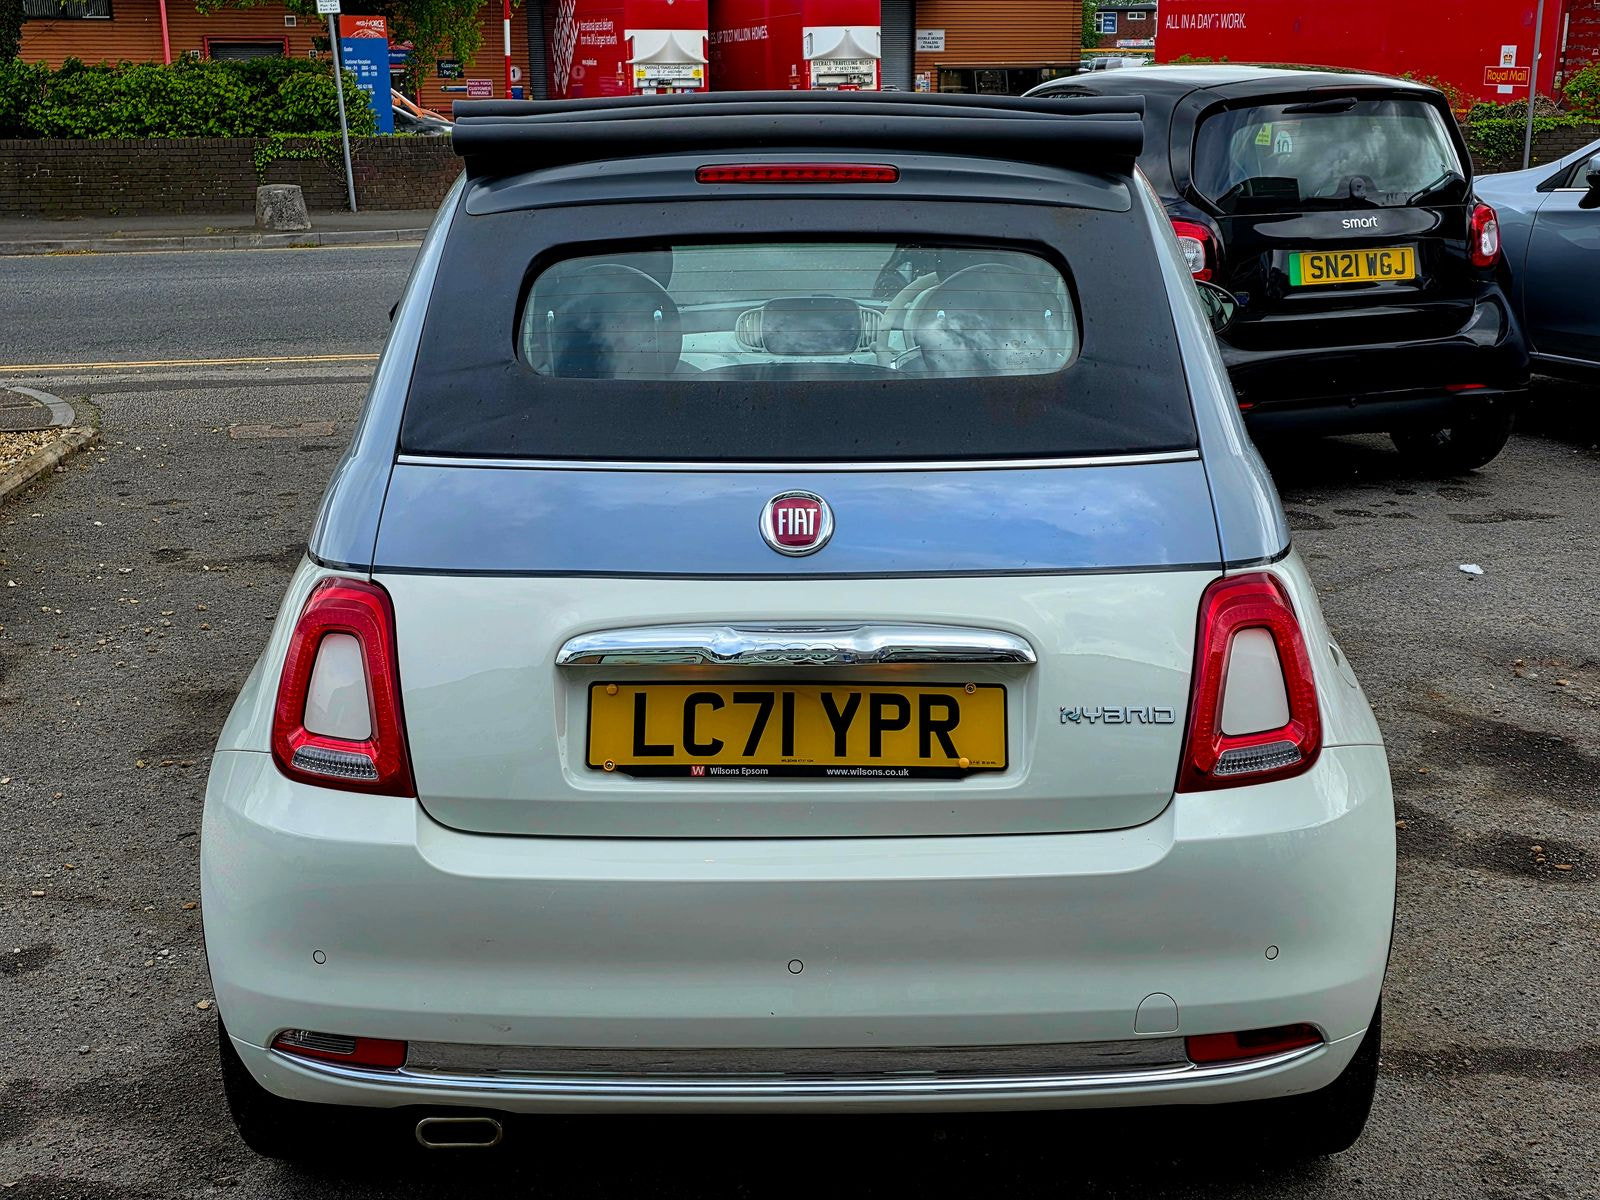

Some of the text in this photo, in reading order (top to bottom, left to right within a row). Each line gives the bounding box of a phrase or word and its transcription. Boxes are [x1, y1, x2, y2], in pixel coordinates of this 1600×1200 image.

[1165, 14, 1179, 29] ALL
[1181, 14, 1189, 29] IN
[1190, 14, 1196, 29] A
[1220, 13, 1247, 29] WORK.
[734, 27, 751, 42] MILLION
[752, 25, 769, 40] HOMES.
[1487, 69, 1527, 82] Royal Mail
[1342, 216, 1378, 229] smart
[1310, 251, 1406, 279] SN21 WGJ
[778, 508, 817, 535] FIAT
[1060, 706, 1176, 724] HYBRID
[633, 692, 961, 758] LC71 YPR
[710, 767, 739, 776] Wilsons
[742, 767, 768, 777] Epsom
[826, 768, 909, 776] www.wilsons.co.uk
